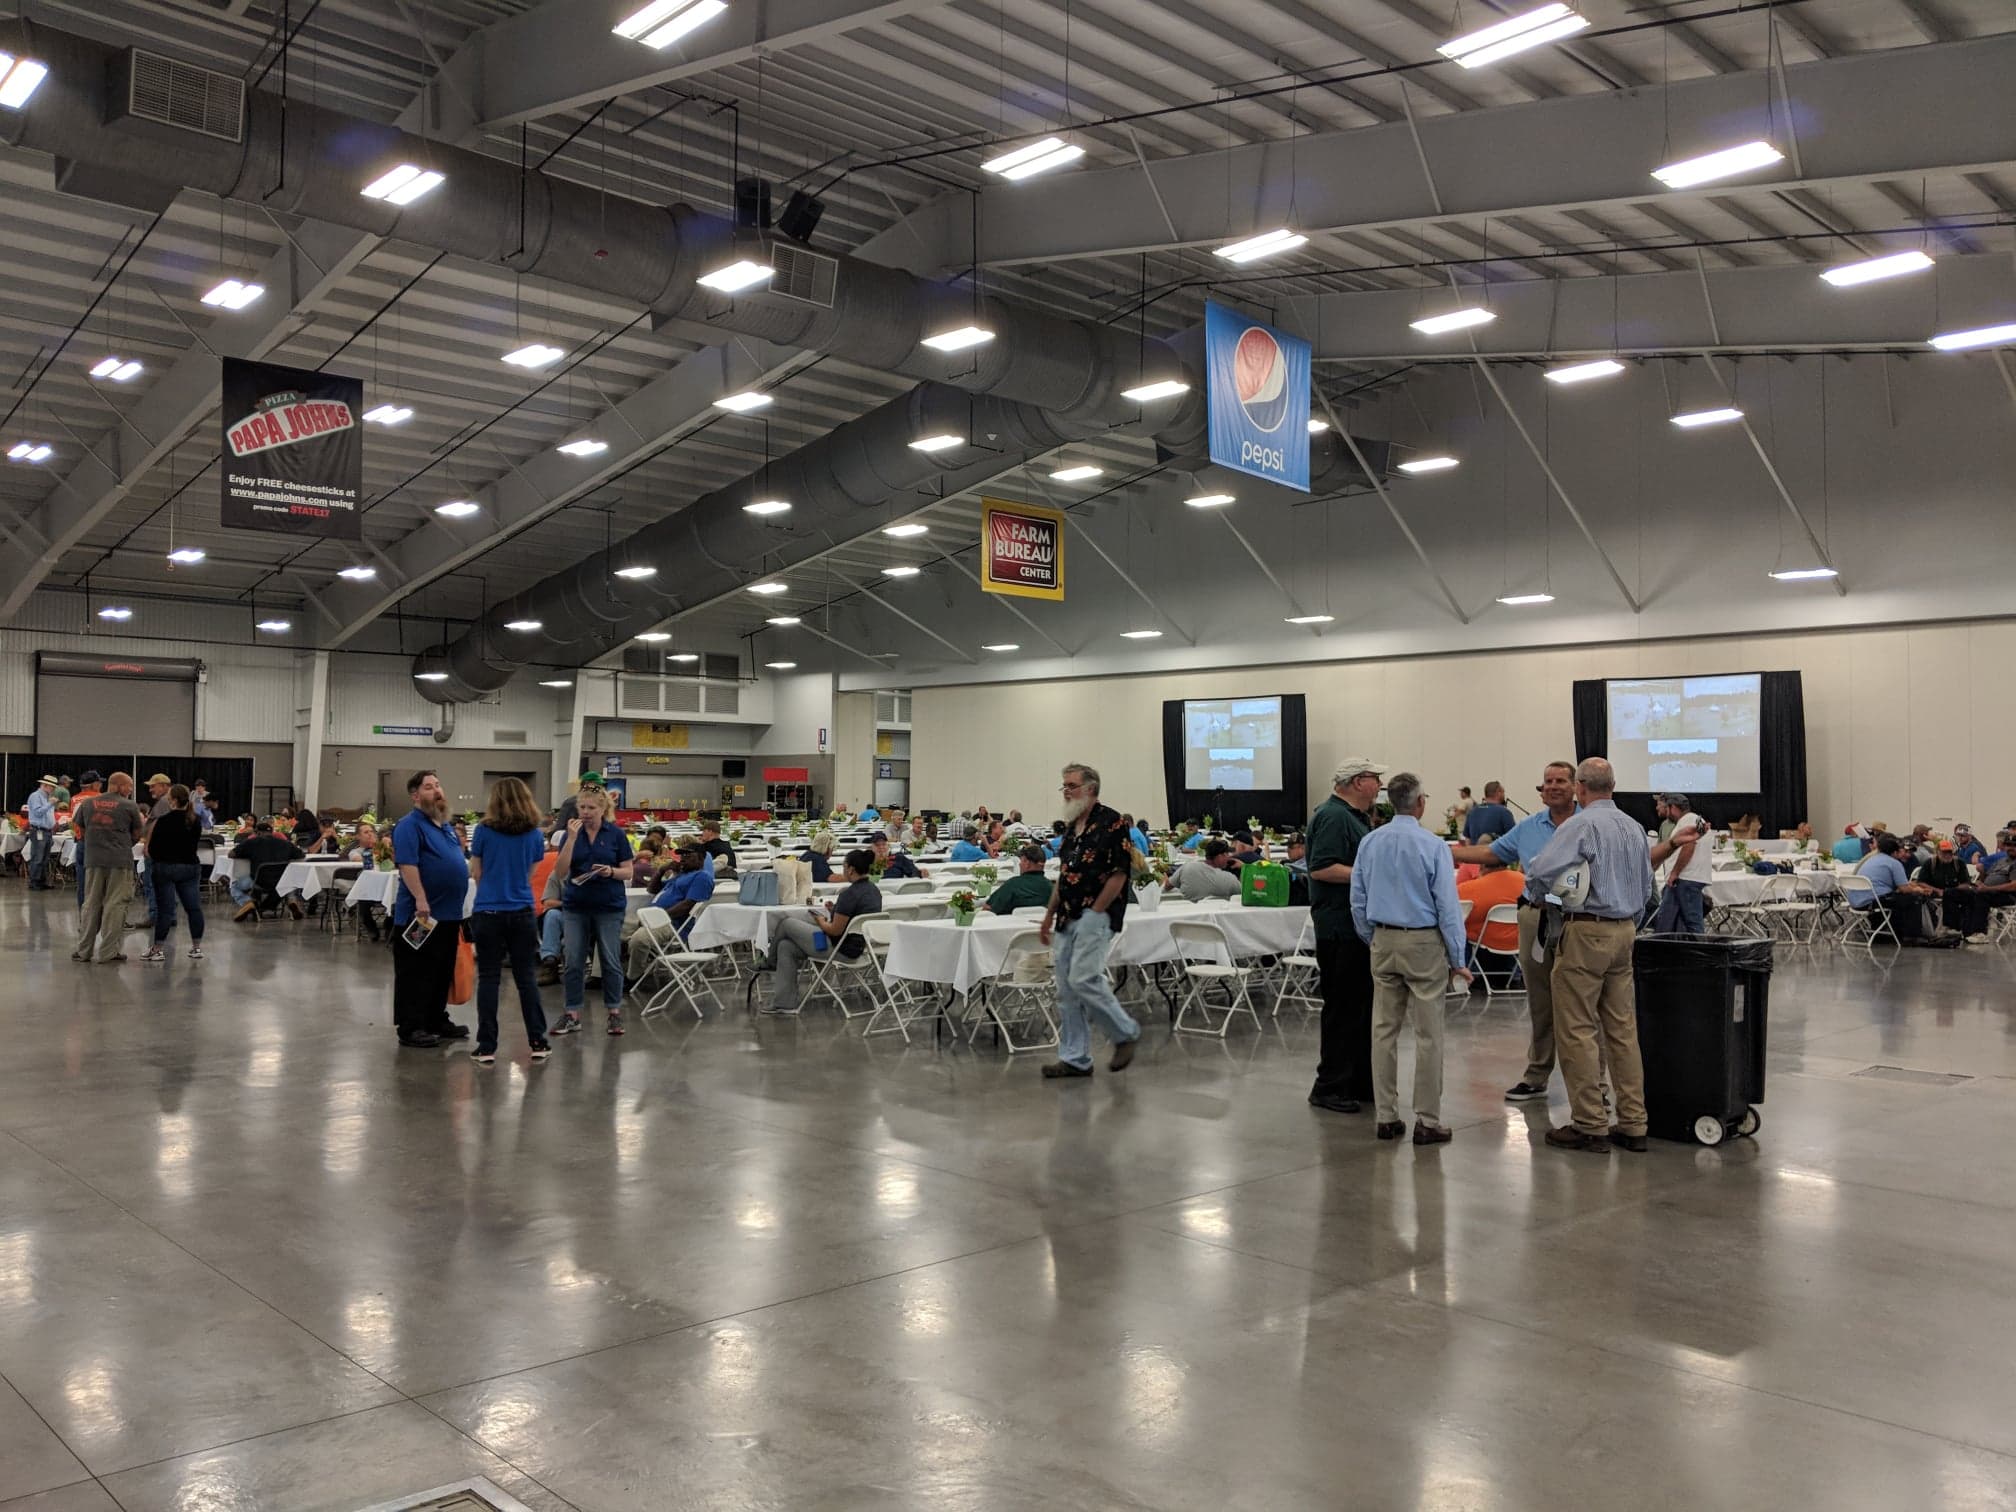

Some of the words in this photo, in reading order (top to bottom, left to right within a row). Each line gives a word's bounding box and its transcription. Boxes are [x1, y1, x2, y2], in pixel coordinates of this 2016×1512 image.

[265, 393, 296, 406] PIZZA
[230, 412, 287, 453] PAPA
[1241, 441, 1283, 471] pepsi
[229, 474, 256, 487] Enjoy
[257, 478, 283, 488] FREE
[284, 482, 344, 496] cheesesticks
[346, 489, 356, 497] at
[231, 488, 328, 507] www.papajohns.com
[329, 500, 354, 510] using
[1011, 523, 1051, 545] FARM
[995, 540, 1053, 563] BUREAU
[1019, 566, 1051, 580] CENTER
